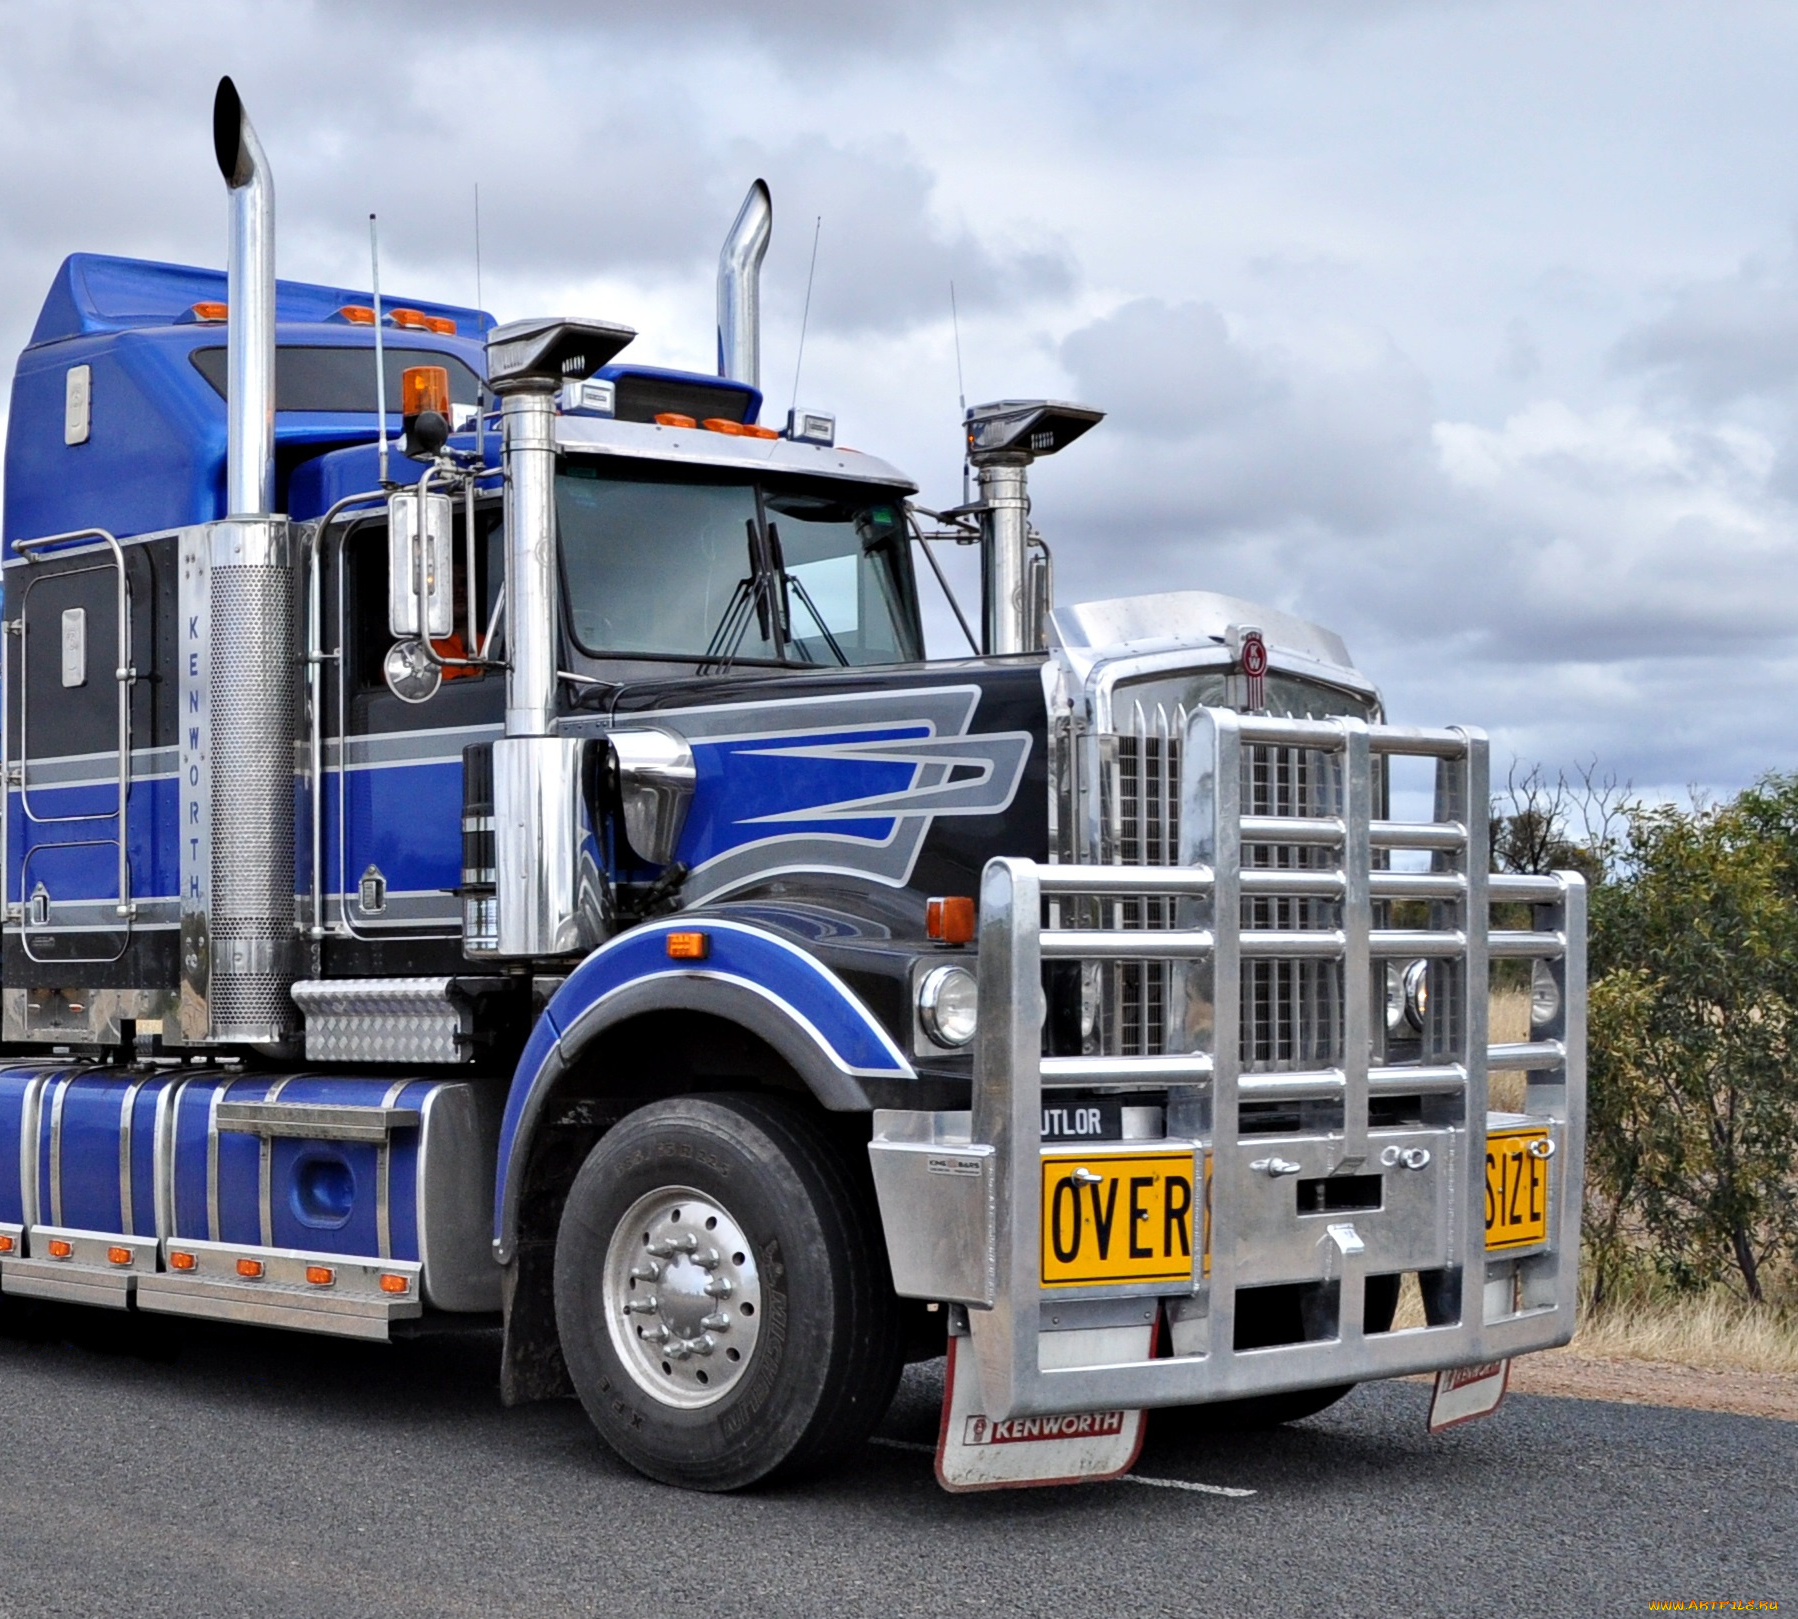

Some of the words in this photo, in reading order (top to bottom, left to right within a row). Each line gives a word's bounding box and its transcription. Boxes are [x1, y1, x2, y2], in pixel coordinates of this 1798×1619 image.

[188, 615, 200, 899] KENWORTH
[1052, 1175, 1192, 1264] OVER
[1485, 1152, 1541, 1230] SIZE
[995, 1412, 1121, 1439] KENWORTH
